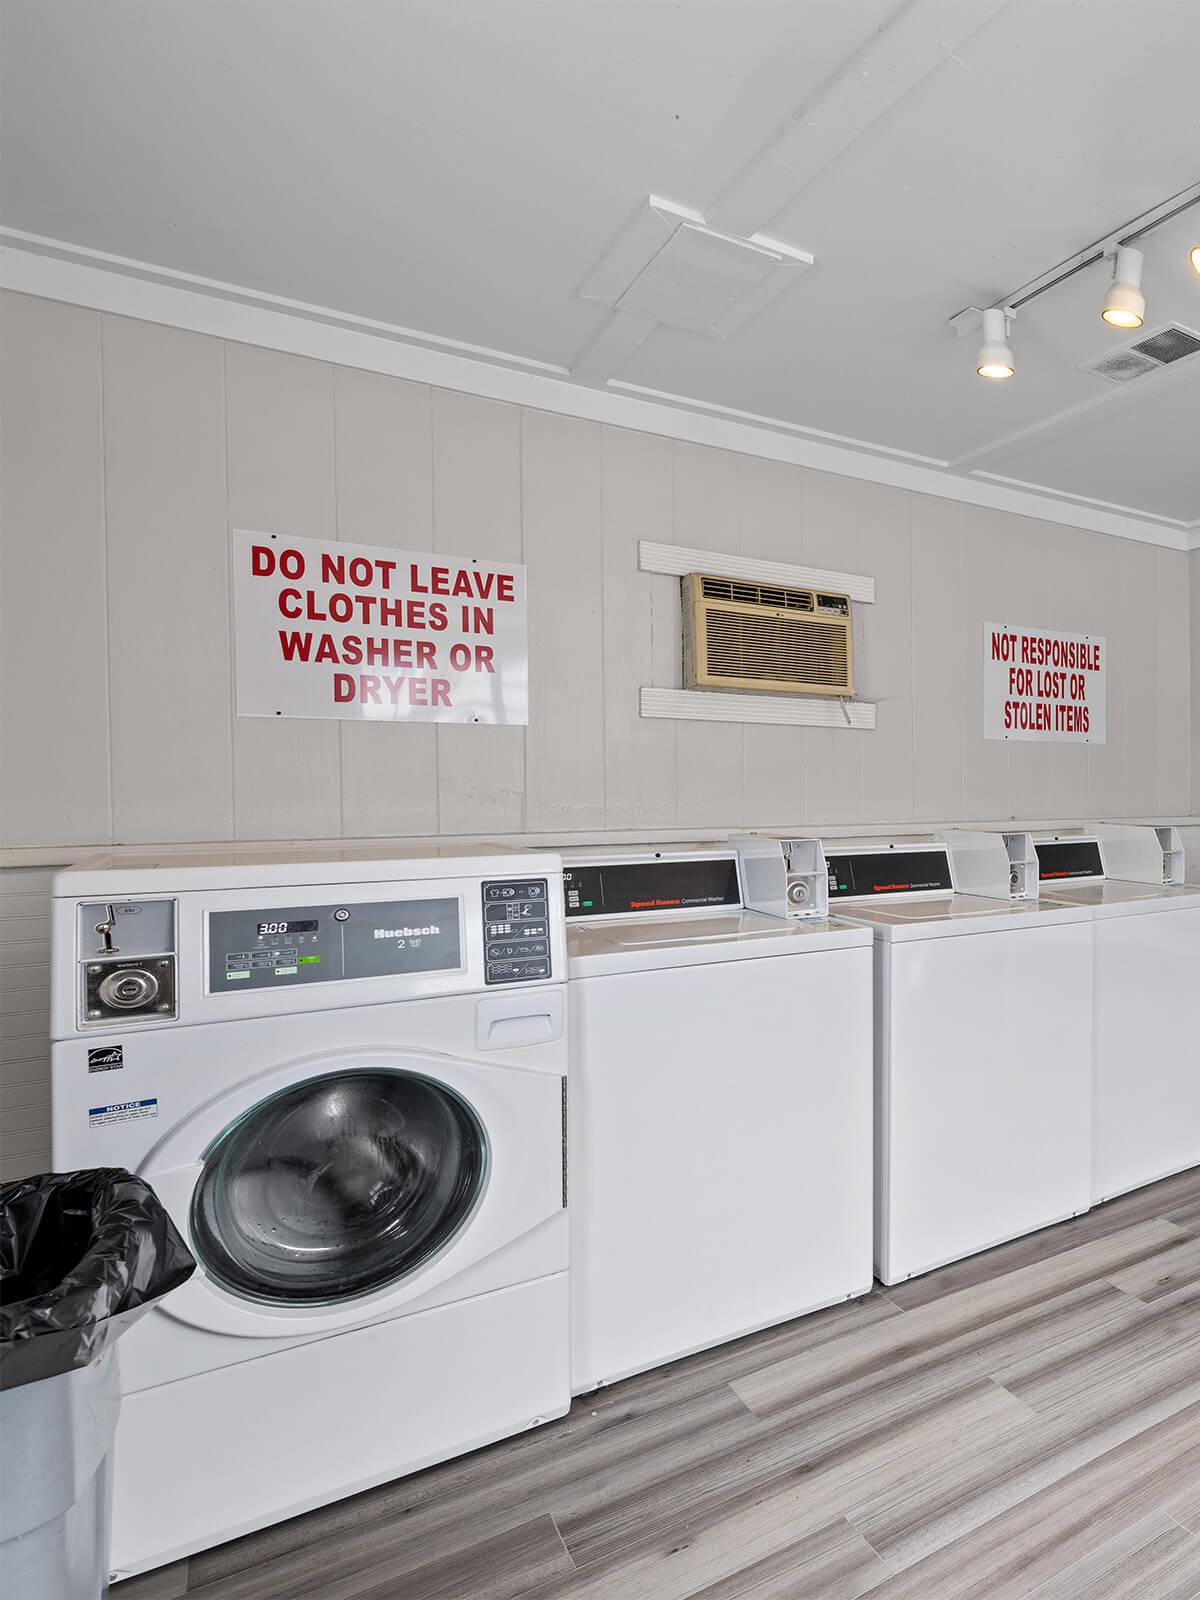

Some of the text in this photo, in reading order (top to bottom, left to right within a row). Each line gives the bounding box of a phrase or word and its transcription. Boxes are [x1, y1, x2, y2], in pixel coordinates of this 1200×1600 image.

[252, 546, 514, 602] DO NOT LEAVE
[278, 588, 494, 634] CLOTHES IN
[278, 630, 496, 673] WASHER OR
[992, 632, 1100, 671] NOT RESPONSIBLE
[334, 673, 452, 706] DRYER
[1010, 668, 1086, 700] FOR LOST OR
[1004, 700, 1089, 732] STOLEN ITEMS
[260, 922, 287, 934] 3.00
[374, 925, 440, 939] Huebsch
[398, 939, 405, 949] 2
[106, 1102, 140, 1112] NOTICE
